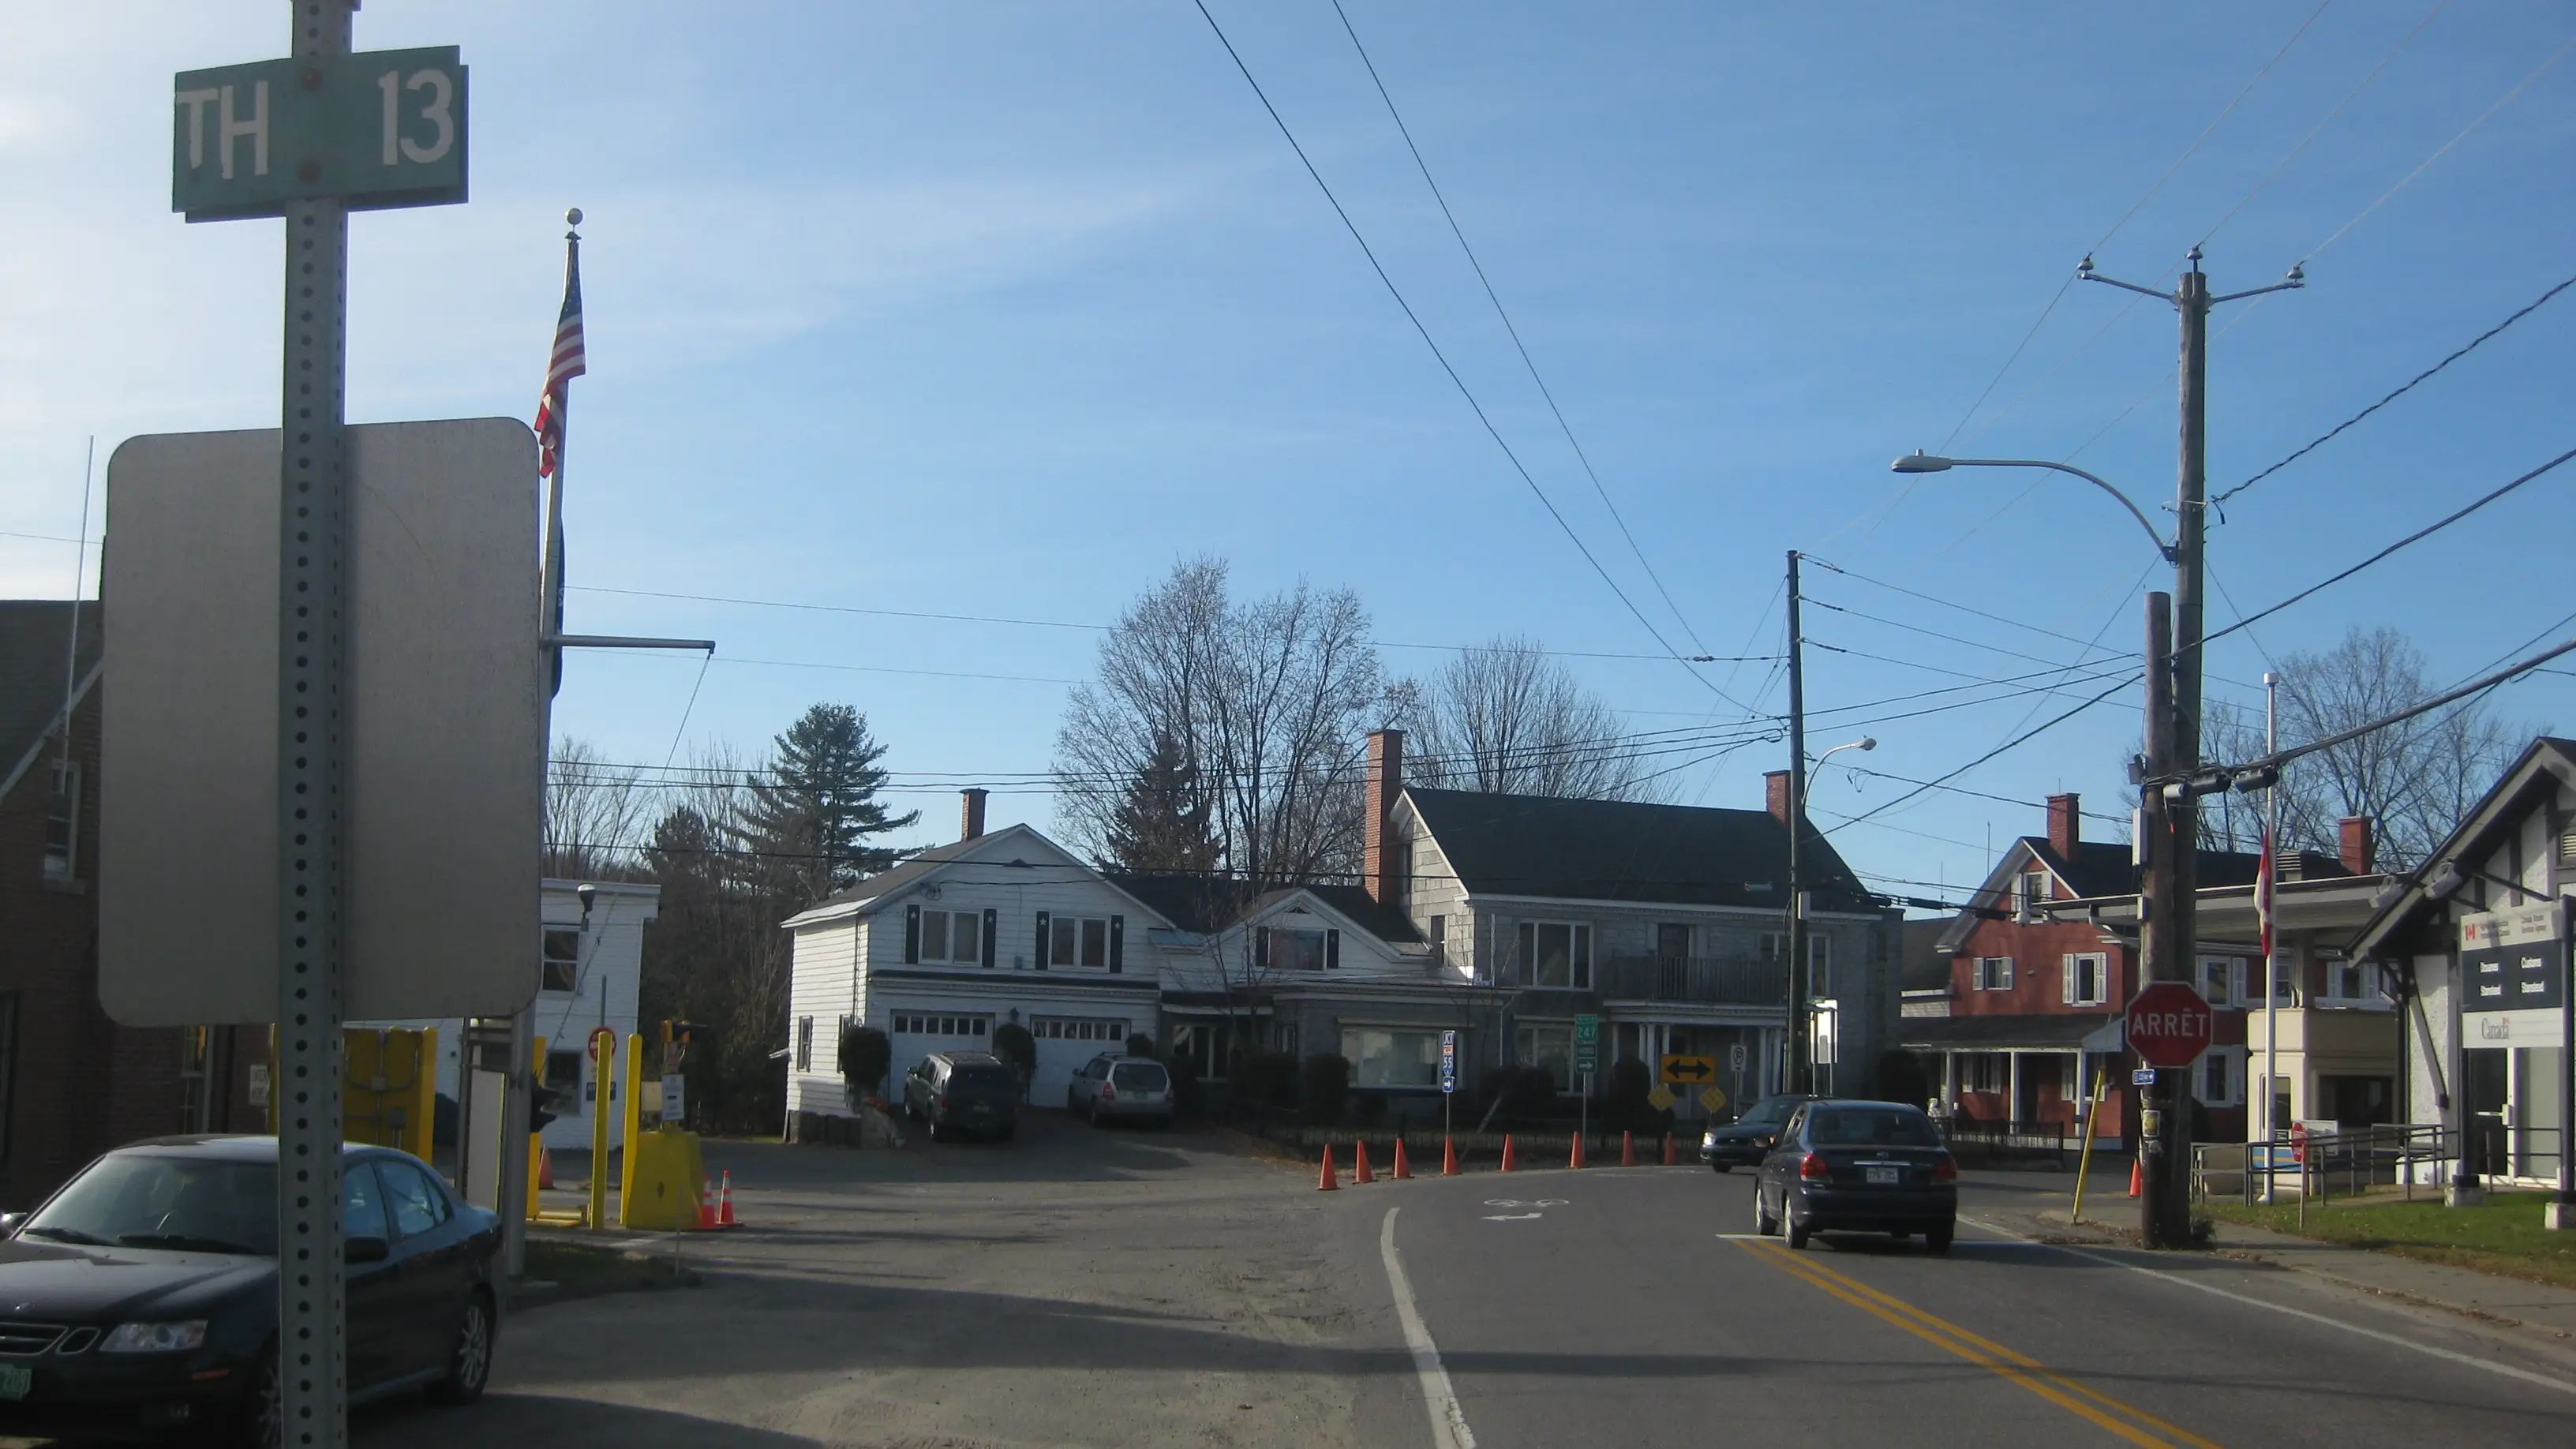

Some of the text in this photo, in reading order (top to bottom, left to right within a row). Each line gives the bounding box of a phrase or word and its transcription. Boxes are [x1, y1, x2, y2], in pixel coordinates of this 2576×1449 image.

[177, 69, 455, 180] TH 13
[1578, 1027, 1595, 1038] 247
[2131, 1007, 2207, 1037] ARRÊT
[1443, 1056, 1452, 1069] 55
